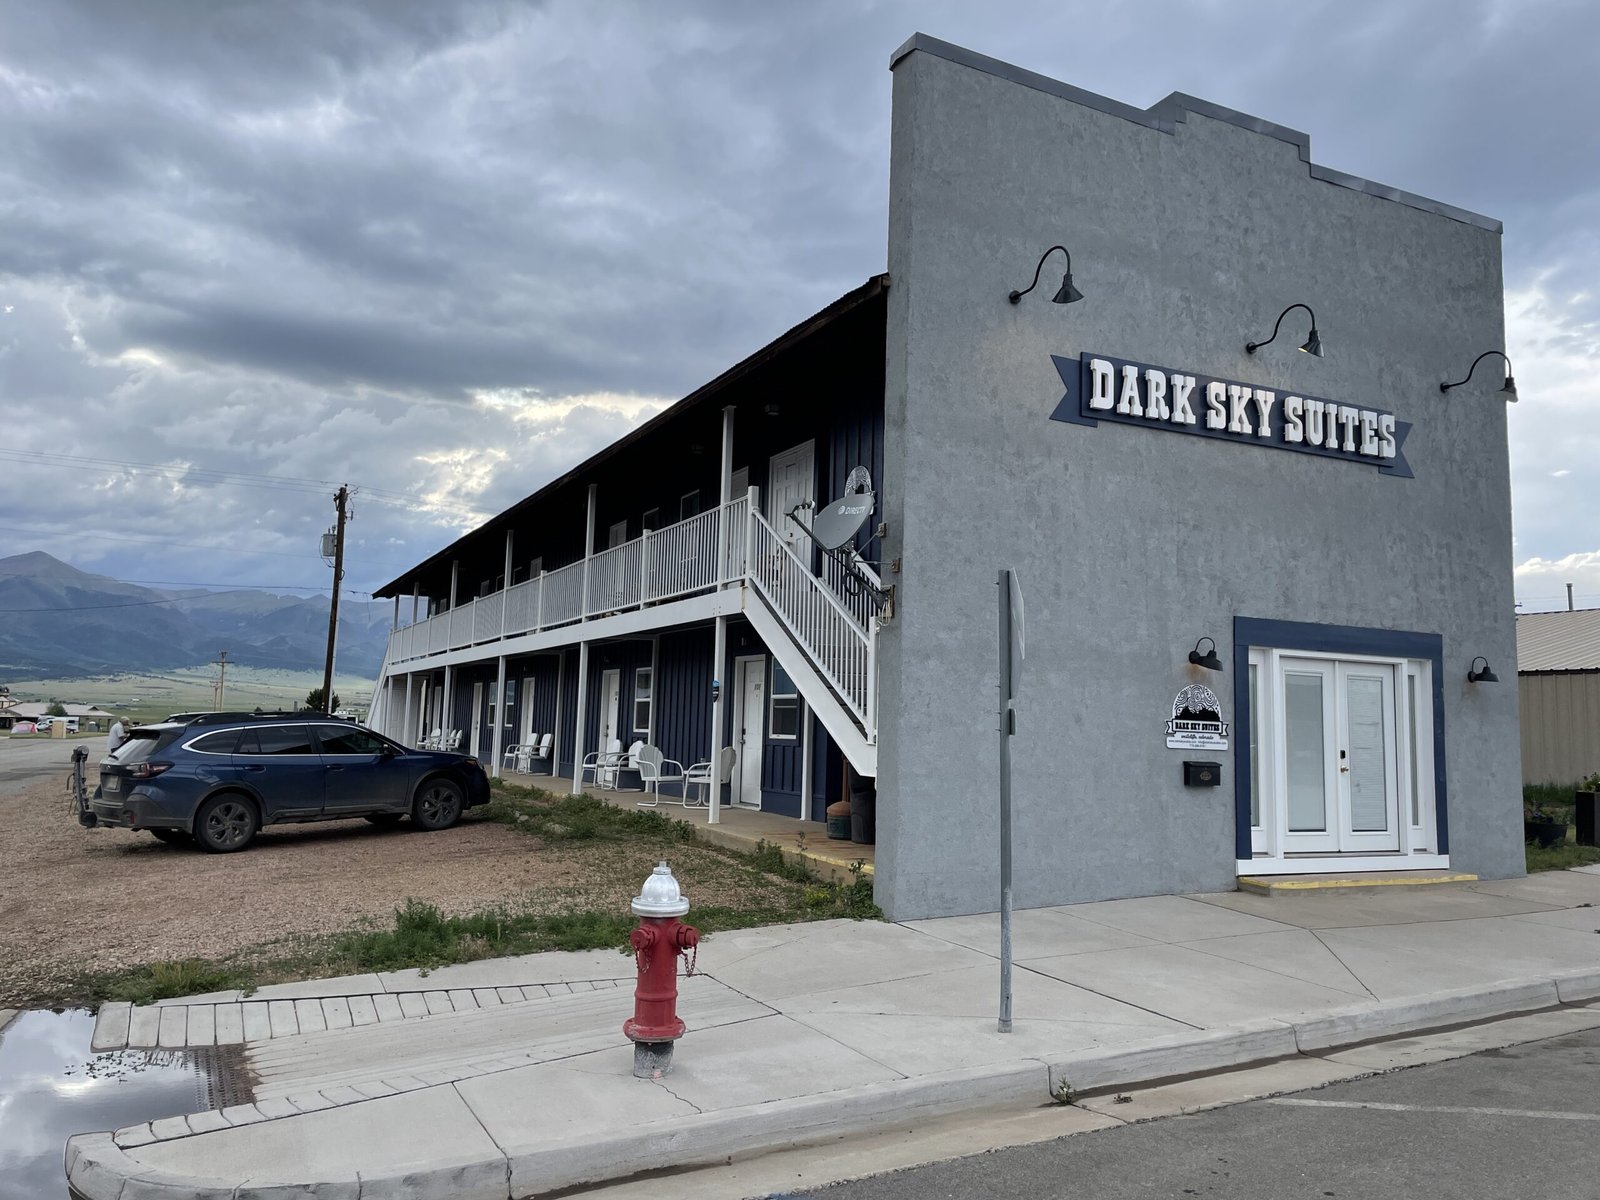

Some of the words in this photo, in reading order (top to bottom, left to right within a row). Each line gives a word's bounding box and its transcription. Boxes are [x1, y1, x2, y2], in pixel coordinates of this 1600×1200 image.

[1089, 358, 1197, 425] DARK
[1206, 381, 1275, 437] SKY
[1284, 396, 1396, 458] SUITES
